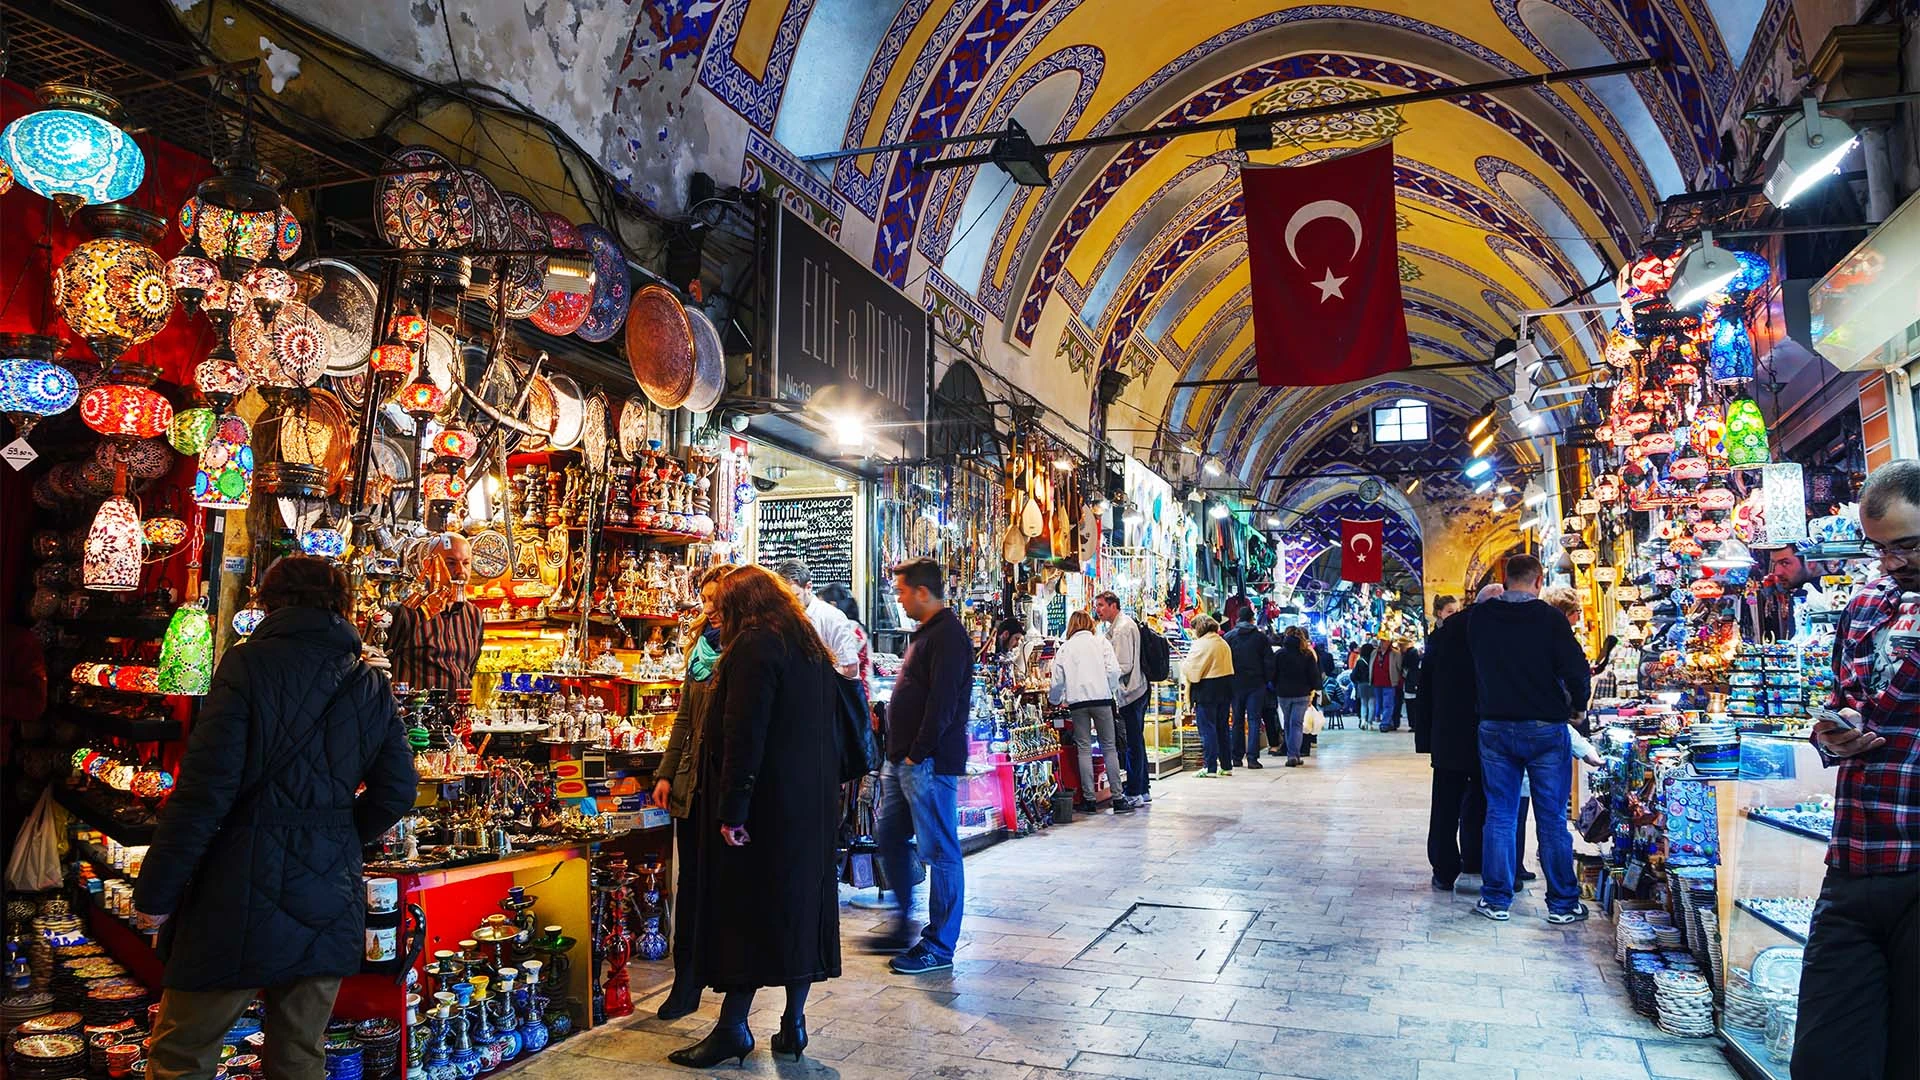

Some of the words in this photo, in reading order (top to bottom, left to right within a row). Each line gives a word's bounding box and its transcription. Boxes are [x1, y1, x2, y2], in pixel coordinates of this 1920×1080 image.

[802, 257, 840, 368] ELİF
[848, 309, 859, 381] &
[865, 300, 911, 411] DENİZ
[785, 373, 811, 402] No:19
